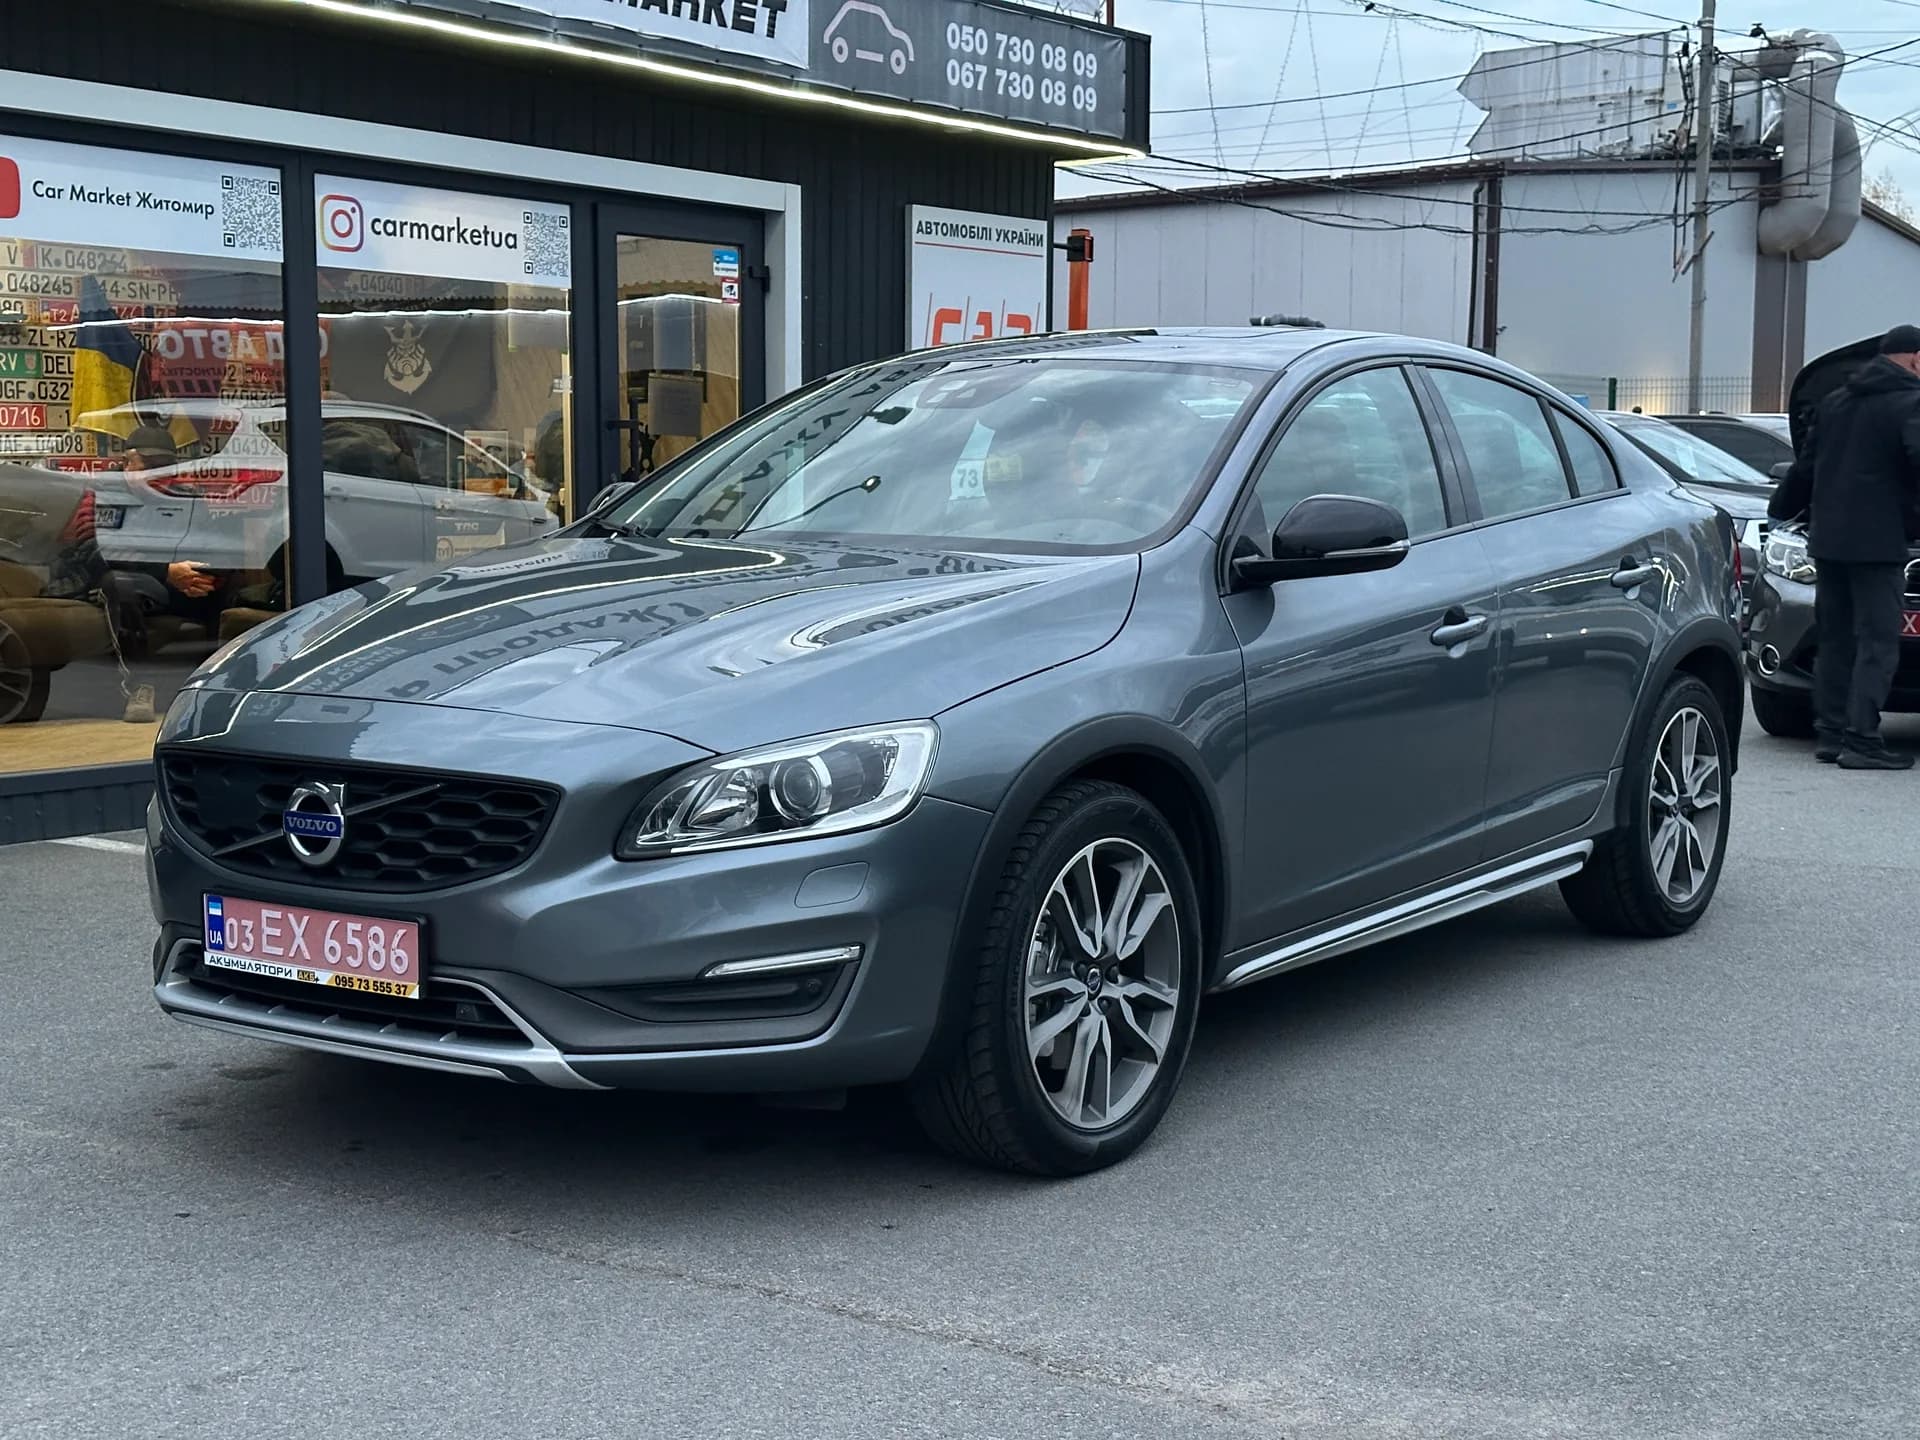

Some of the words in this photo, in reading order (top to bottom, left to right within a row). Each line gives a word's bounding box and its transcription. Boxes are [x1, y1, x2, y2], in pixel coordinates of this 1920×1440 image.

[947, 22, 988, 55] 050
[996, 32, 1034, 66] 730
[1041, 43, 1066, 72] 08
[1072, 50, 1098, 78] 09
[947, 58, 988, 92] 067
[995, 68, 1034, 101] 730
[1041, 78, 1066, 106] 08
[1072, 84, 1097, 112] 09
[32, 180, 64, 201] Car
[69, 185, 132, 207] Market
[136, 191, 215, 219] Житомир
[371, 217, 518, 250] carmarketua
[916, 220, 992, 241] АВТОМОБІЛІ
[995, 228, 1044, 248] УКРАЇНИ
[957, 468, 979, 489] 73
[286, 816, 337, 832] VOLVO
[209, 930, 223, 945] UA
[323, 919, 409, 975] 6586
[209, 955, 293, 979] АКУМУЛЯТОРИ
[334, 974, 354, 988] 095
[357, 977, 371, 991] 73
[373, 980, 392, 994] 555
[395, 983, 409, 996] 37
